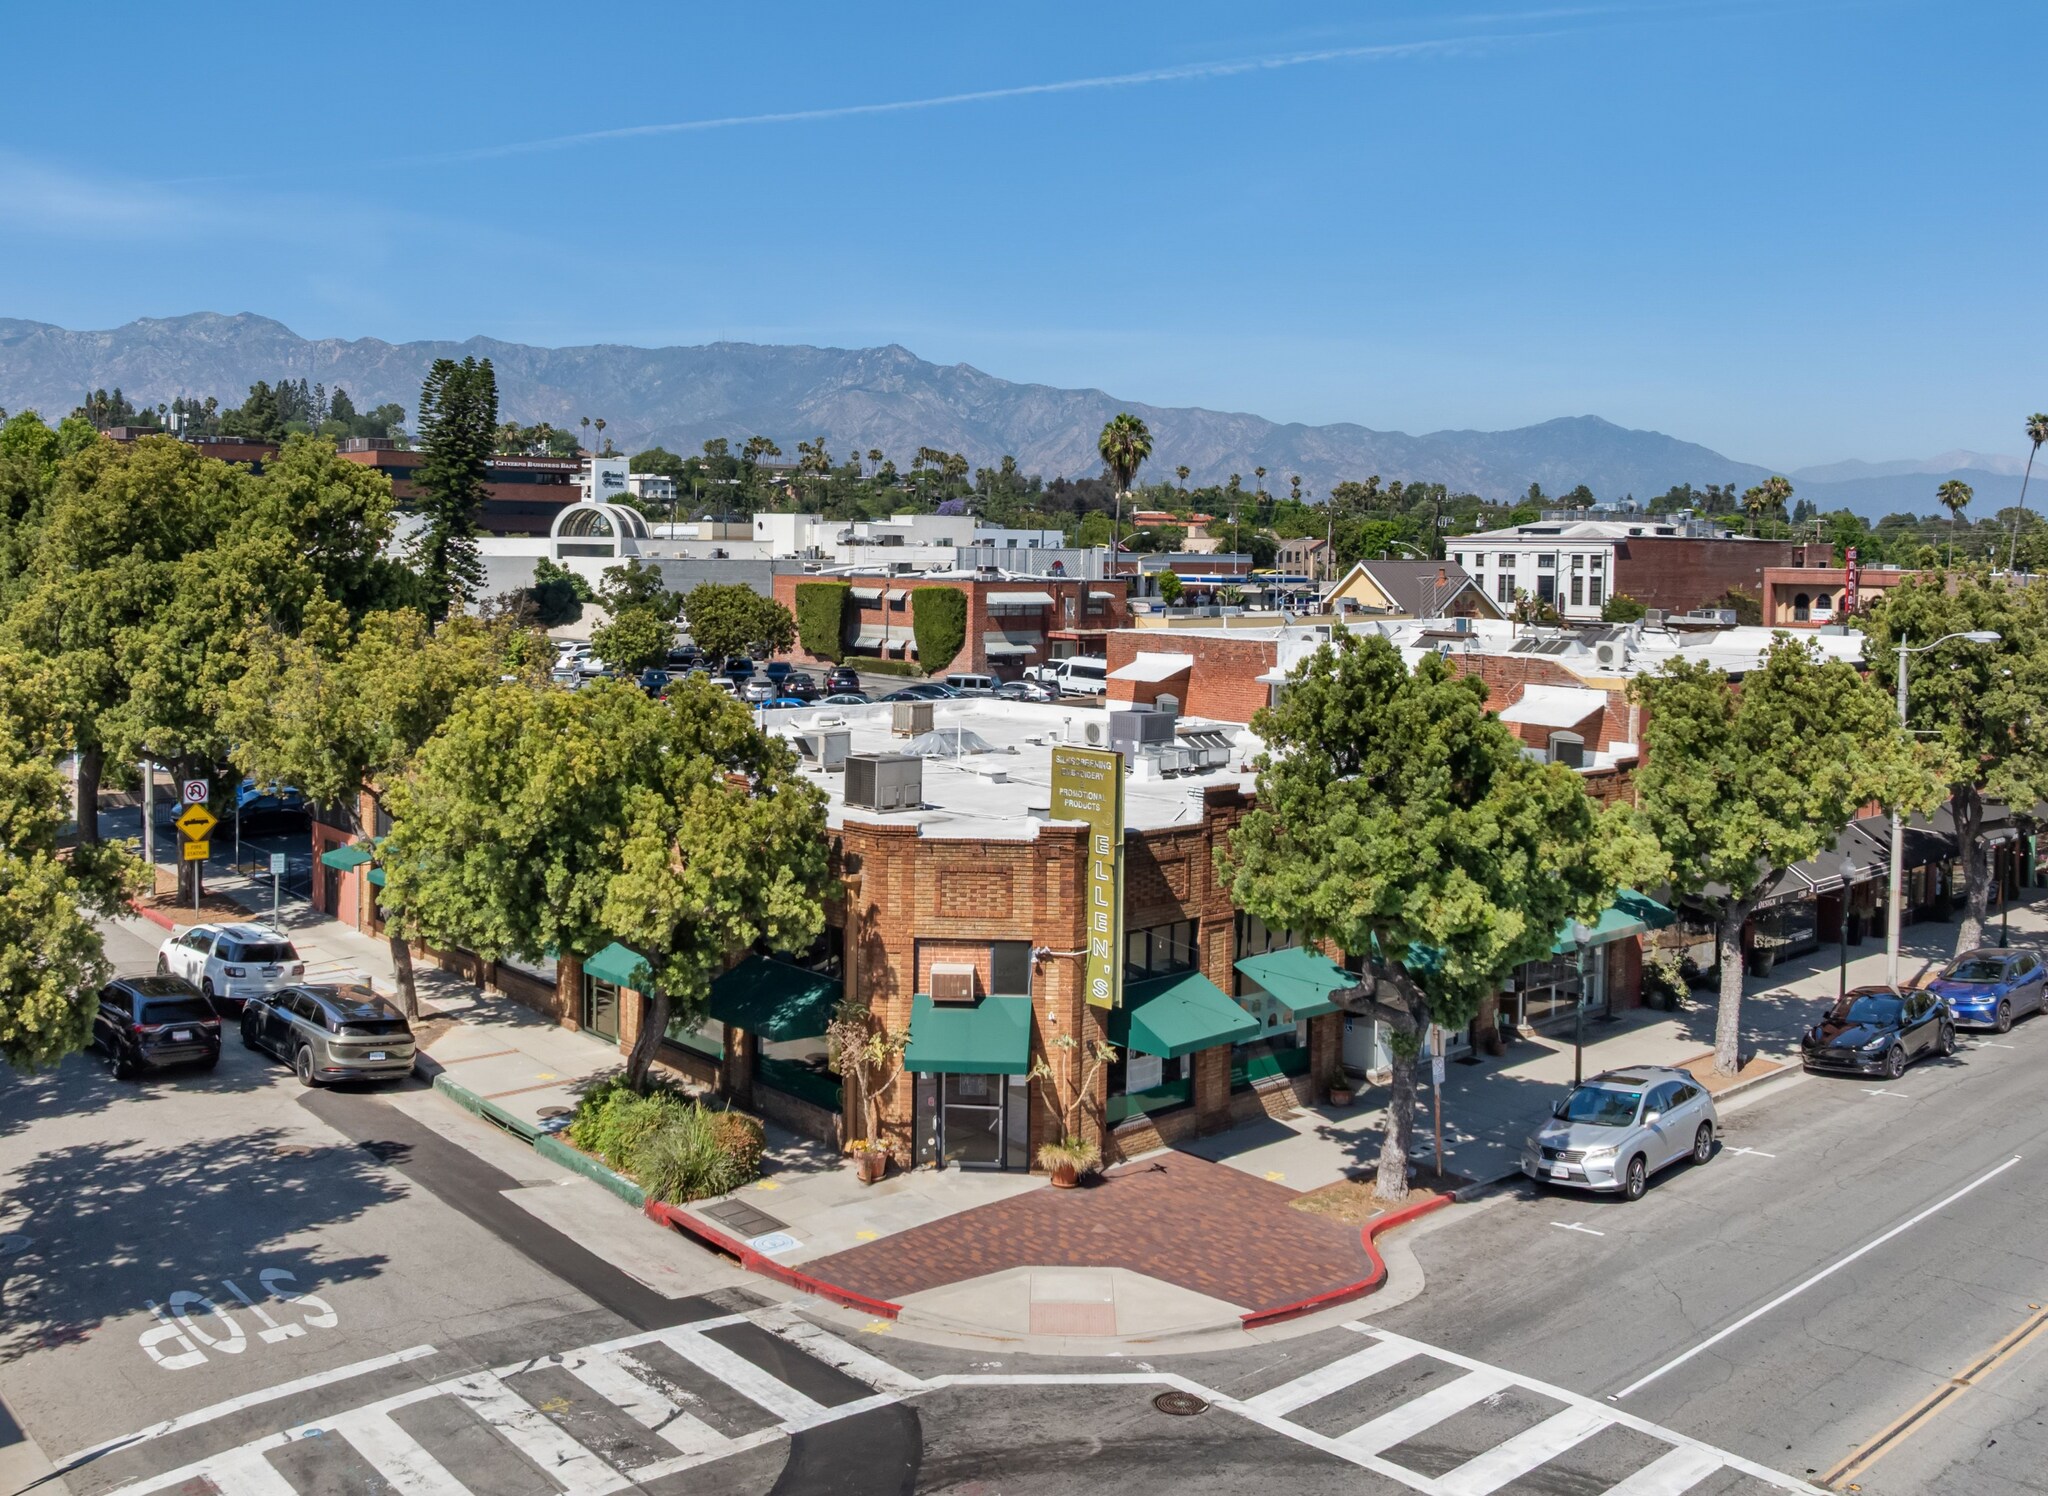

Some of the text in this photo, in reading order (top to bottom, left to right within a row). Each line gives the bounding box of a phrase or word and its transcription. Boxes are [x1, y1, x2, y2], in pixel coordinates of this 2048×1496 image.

[1059, 788, 1106, 802] PROMOTIONAL
[1064, 799, 1101, 812] PRODUCTS
[1092, 834, 1111, 999] ELLEN'S
[138, 1267, 338, 1370] STOP
